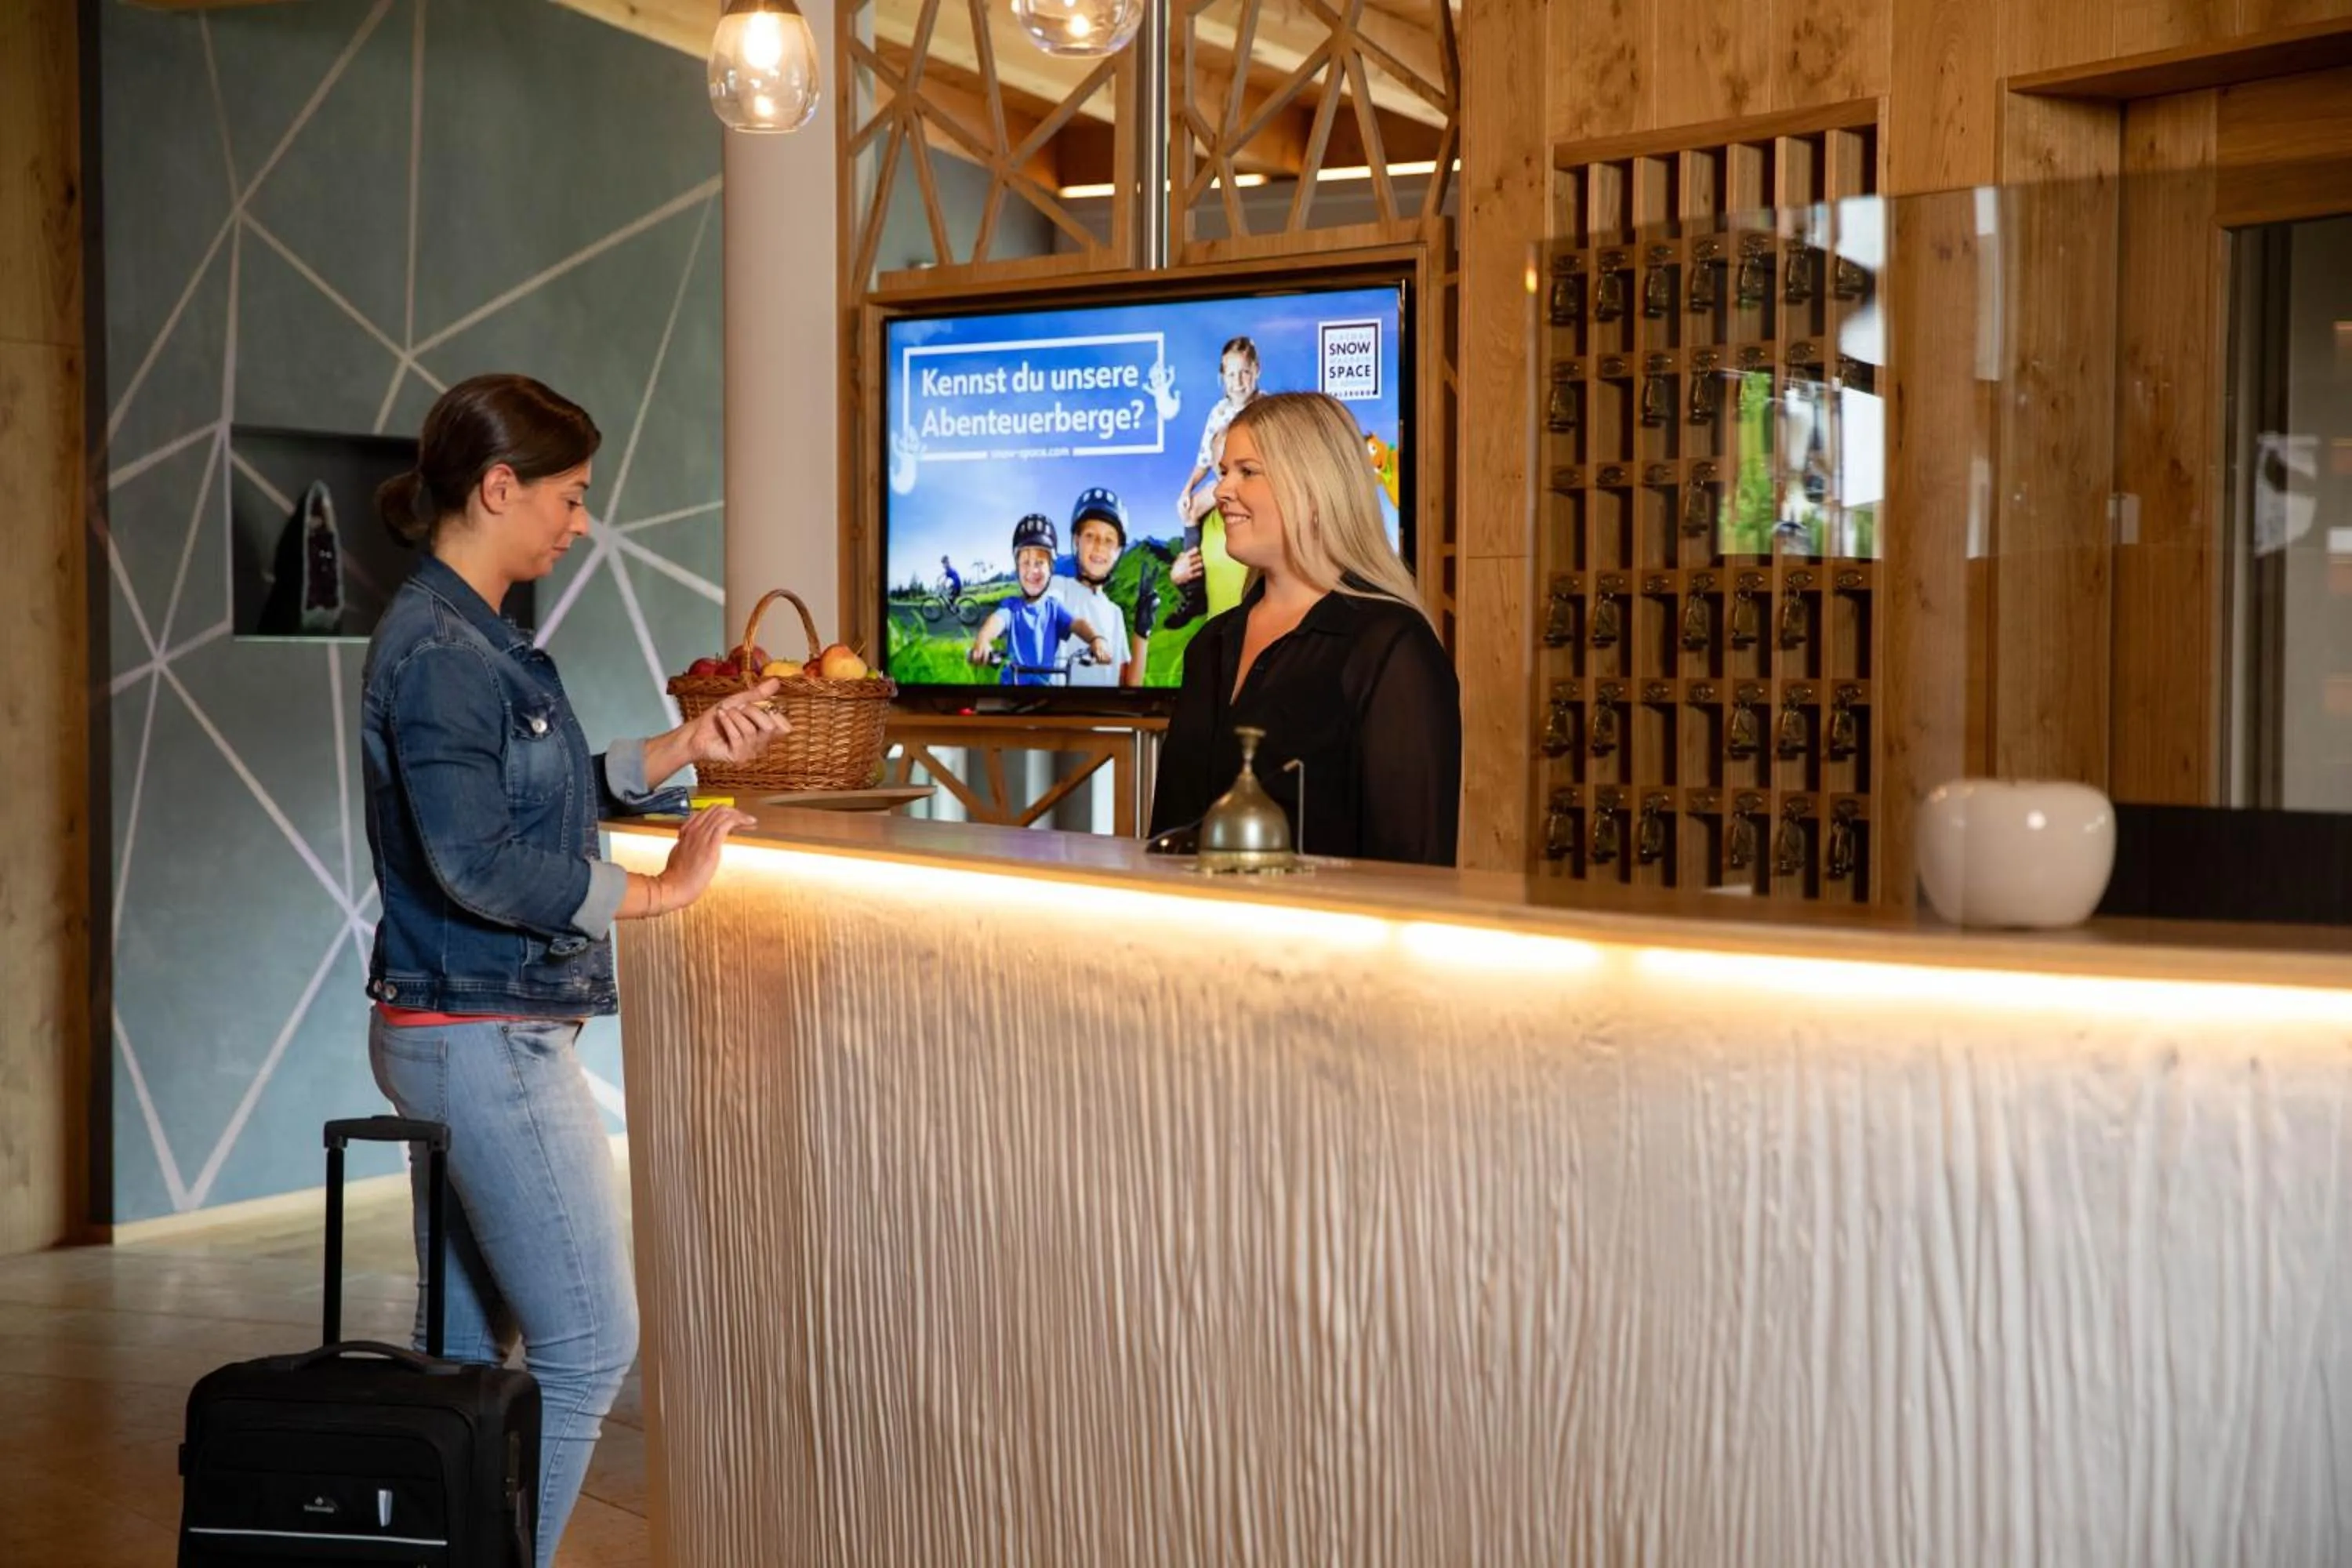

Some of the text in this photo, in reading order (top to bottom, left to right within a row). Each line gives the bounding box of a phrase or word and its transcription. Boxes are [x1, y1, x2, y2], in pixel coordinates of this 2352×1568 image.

[1329, 342, 1370, 355] SNOW
[921, 361, 1138, 397] Kennst du unsere
[1329, 365, 1371, 379] SPACE
[921, 399, 1145, 440] Abenteuerberge?
